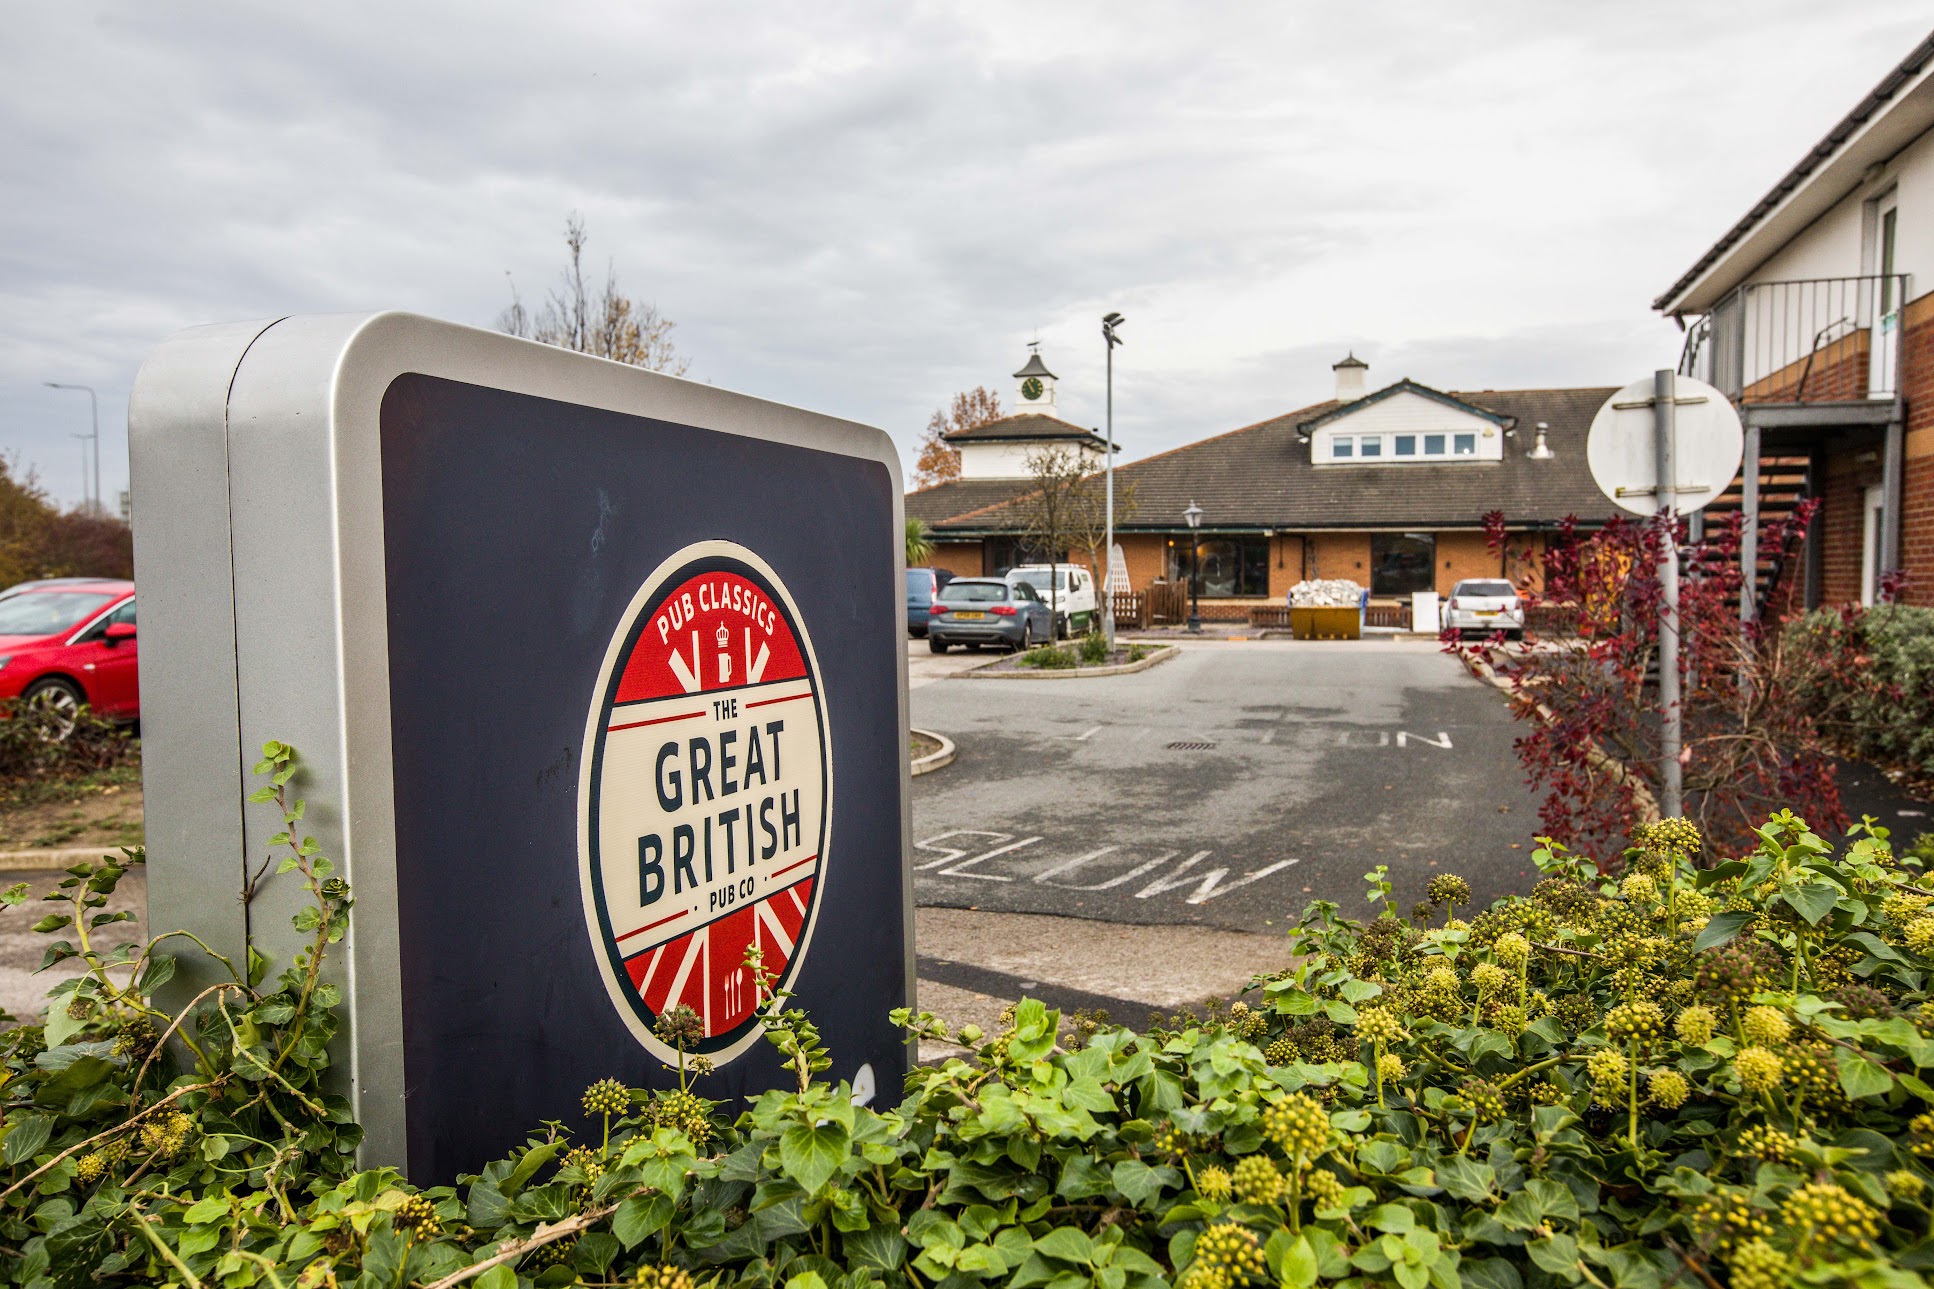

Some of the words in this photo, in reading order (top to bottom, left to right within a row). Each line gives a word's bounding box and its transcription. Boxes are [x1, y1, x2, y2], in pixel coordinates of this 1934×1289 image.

[656, 592, 695, 646] PUB
[698, 582, 776, 636] CLASSICS
[713, 698, 738, 721] THE
[655, 719, 784, 813] GREAT
[638, 788, 801, 908] BRITISH
[914, 830, 1300, 905] SLOW
[710, 884, 735, 913] PUB
[739, 876, 755, 899] CO
